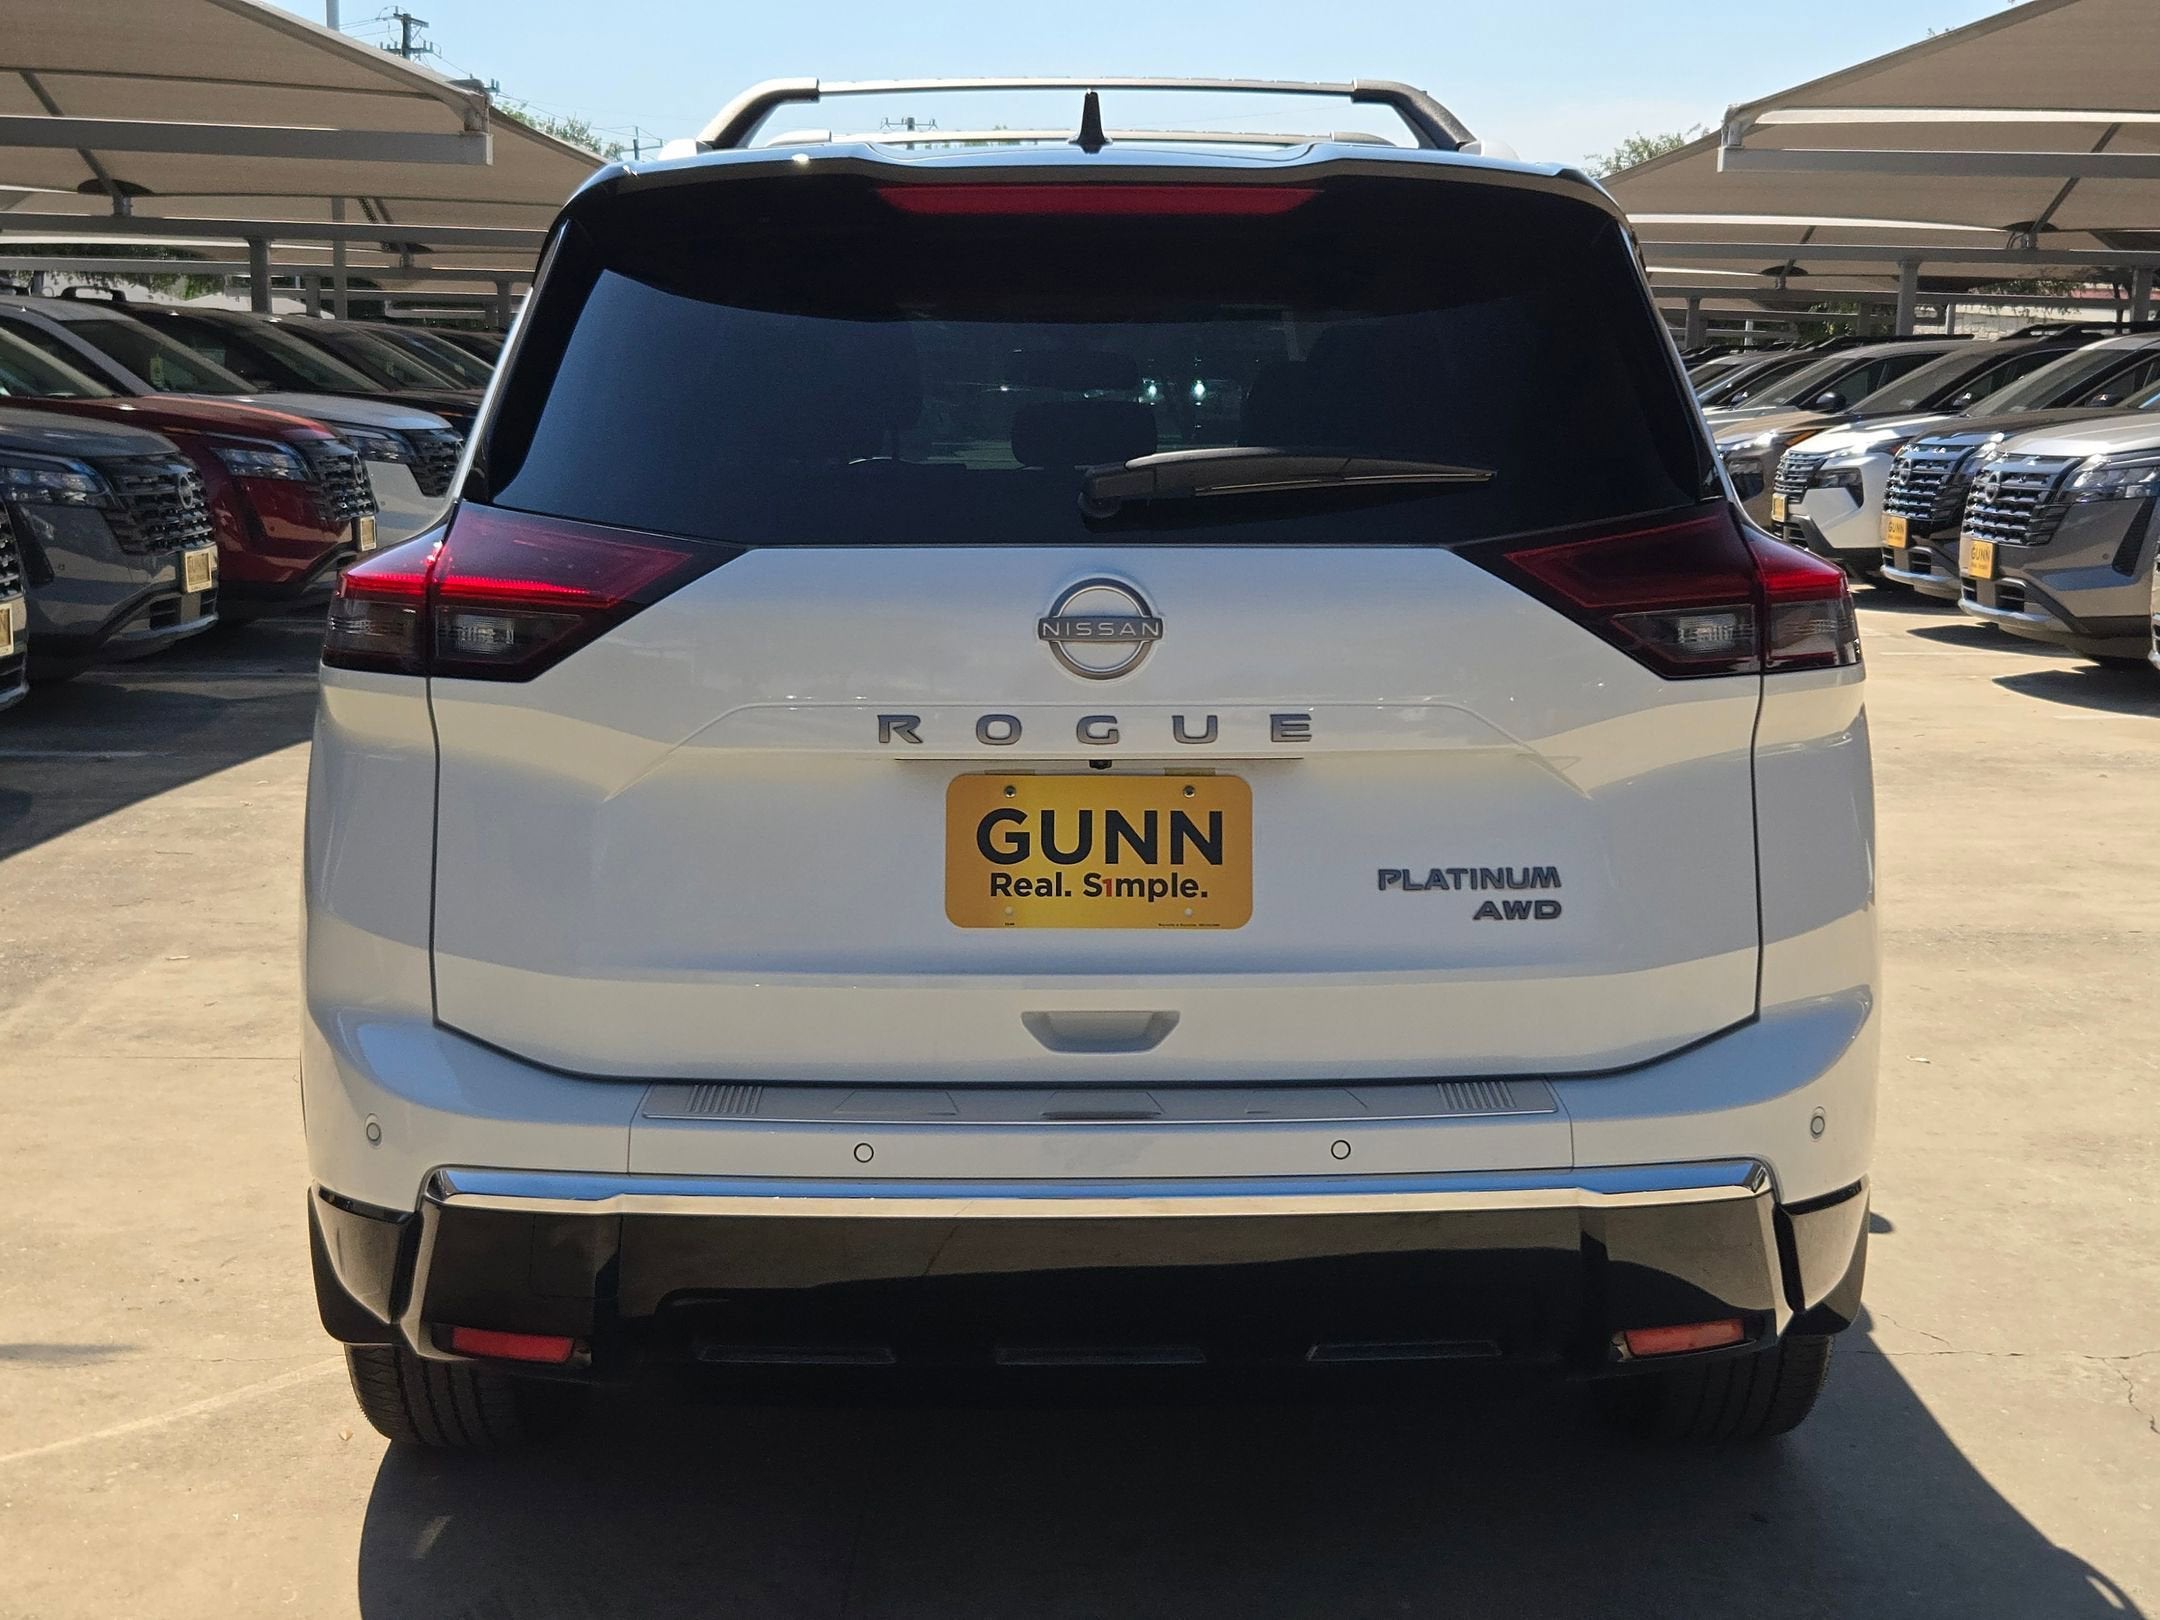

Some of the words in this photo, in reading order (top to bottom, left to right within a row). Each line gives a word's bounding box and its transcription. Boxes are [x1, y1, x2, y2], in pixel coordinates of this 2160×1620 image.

[1971, 546, 1991, 560] GUNN
[1042, 621, 1159, 637] NISSAN
[877, 714, 1312, 745] ROGUE
[977, 808, 1223, 865] GUNN
[990, 871, 1073, 898] Real.
[1377, 866, 1563, 892] PLATINUM
[1472, 900, 1563, 921] AWD
